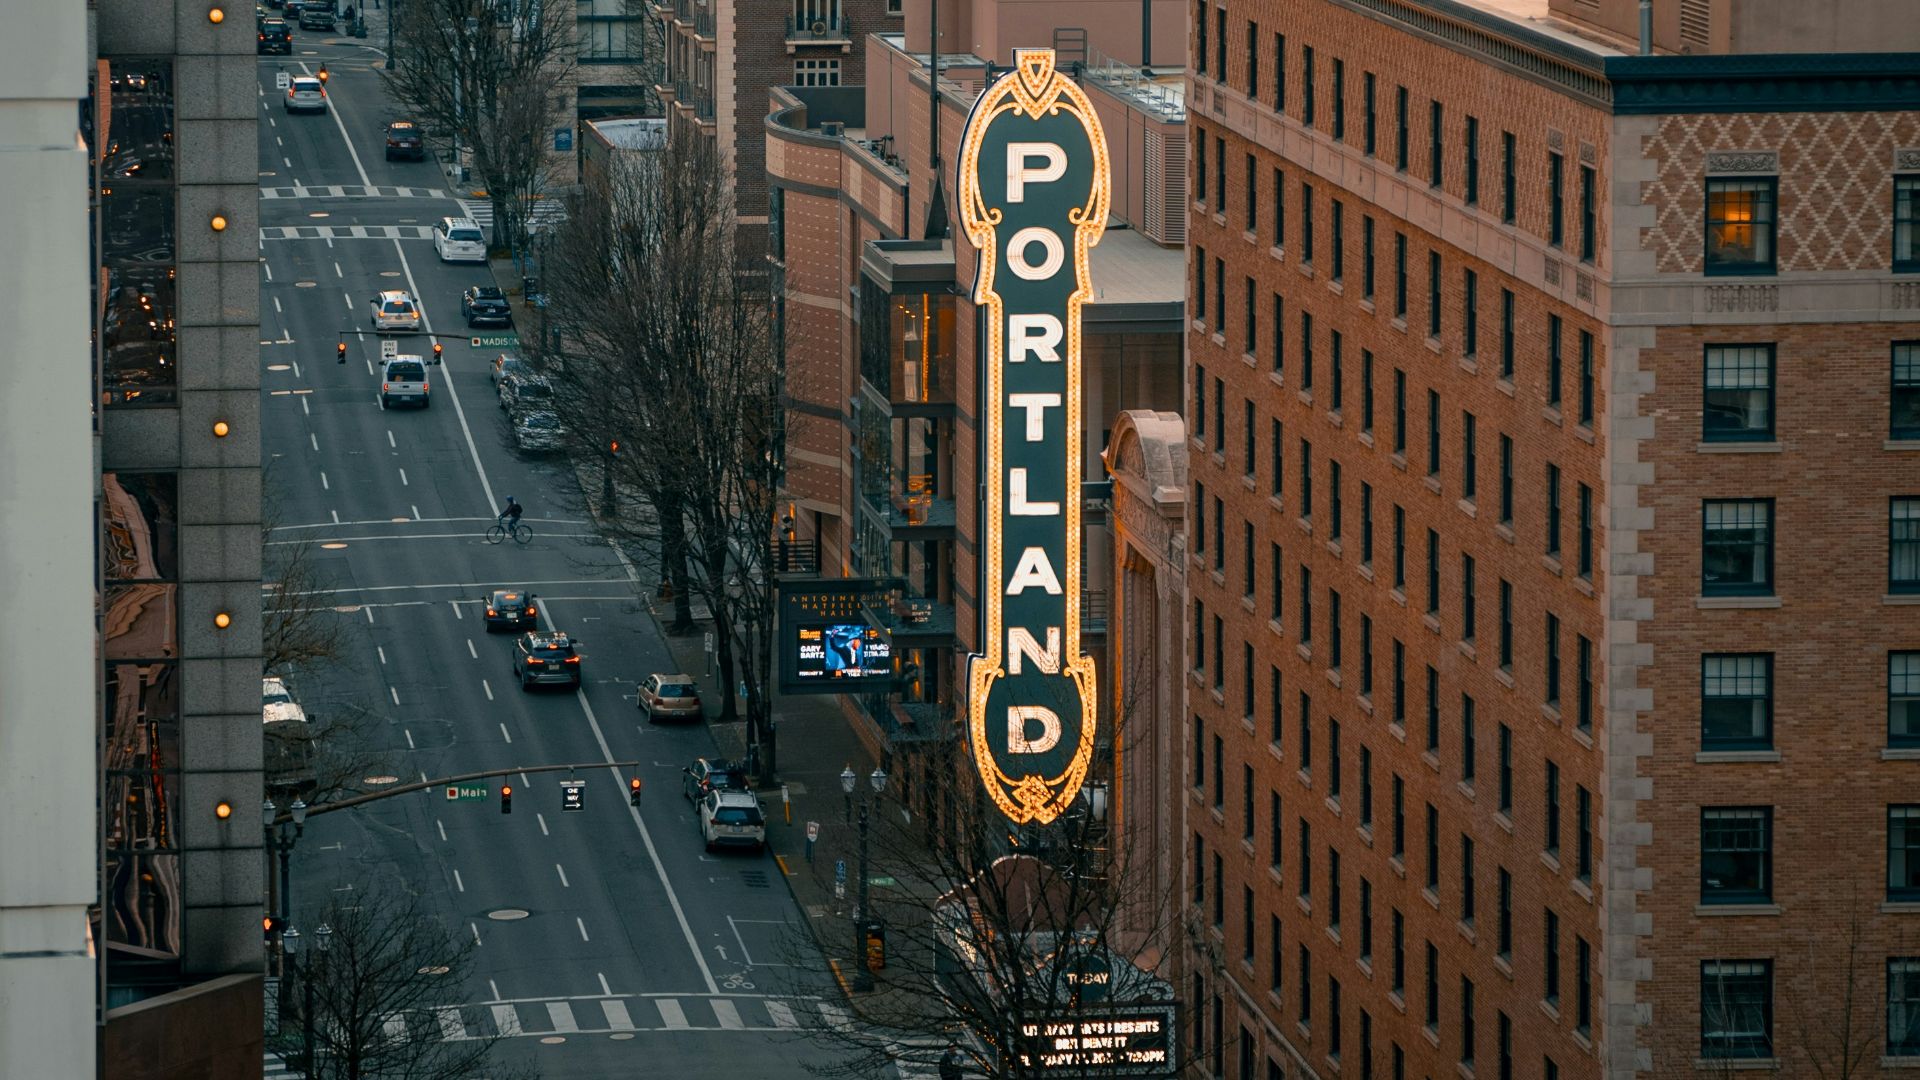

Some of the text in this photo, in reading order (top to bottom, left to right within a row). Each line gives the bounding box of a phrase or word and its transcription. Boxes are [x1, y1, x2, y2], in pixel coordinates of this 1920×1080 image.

[482, 337, 520, 346] MADISON
[1007, 142, 1068, 753] PORTLAND
[800, 645, 821, 654] GARY
[800, 651, 825, 659] BARTZ
[461, 788, 487, 797] Main
[1107, 1021, 1160, 1033] PRESENTS
